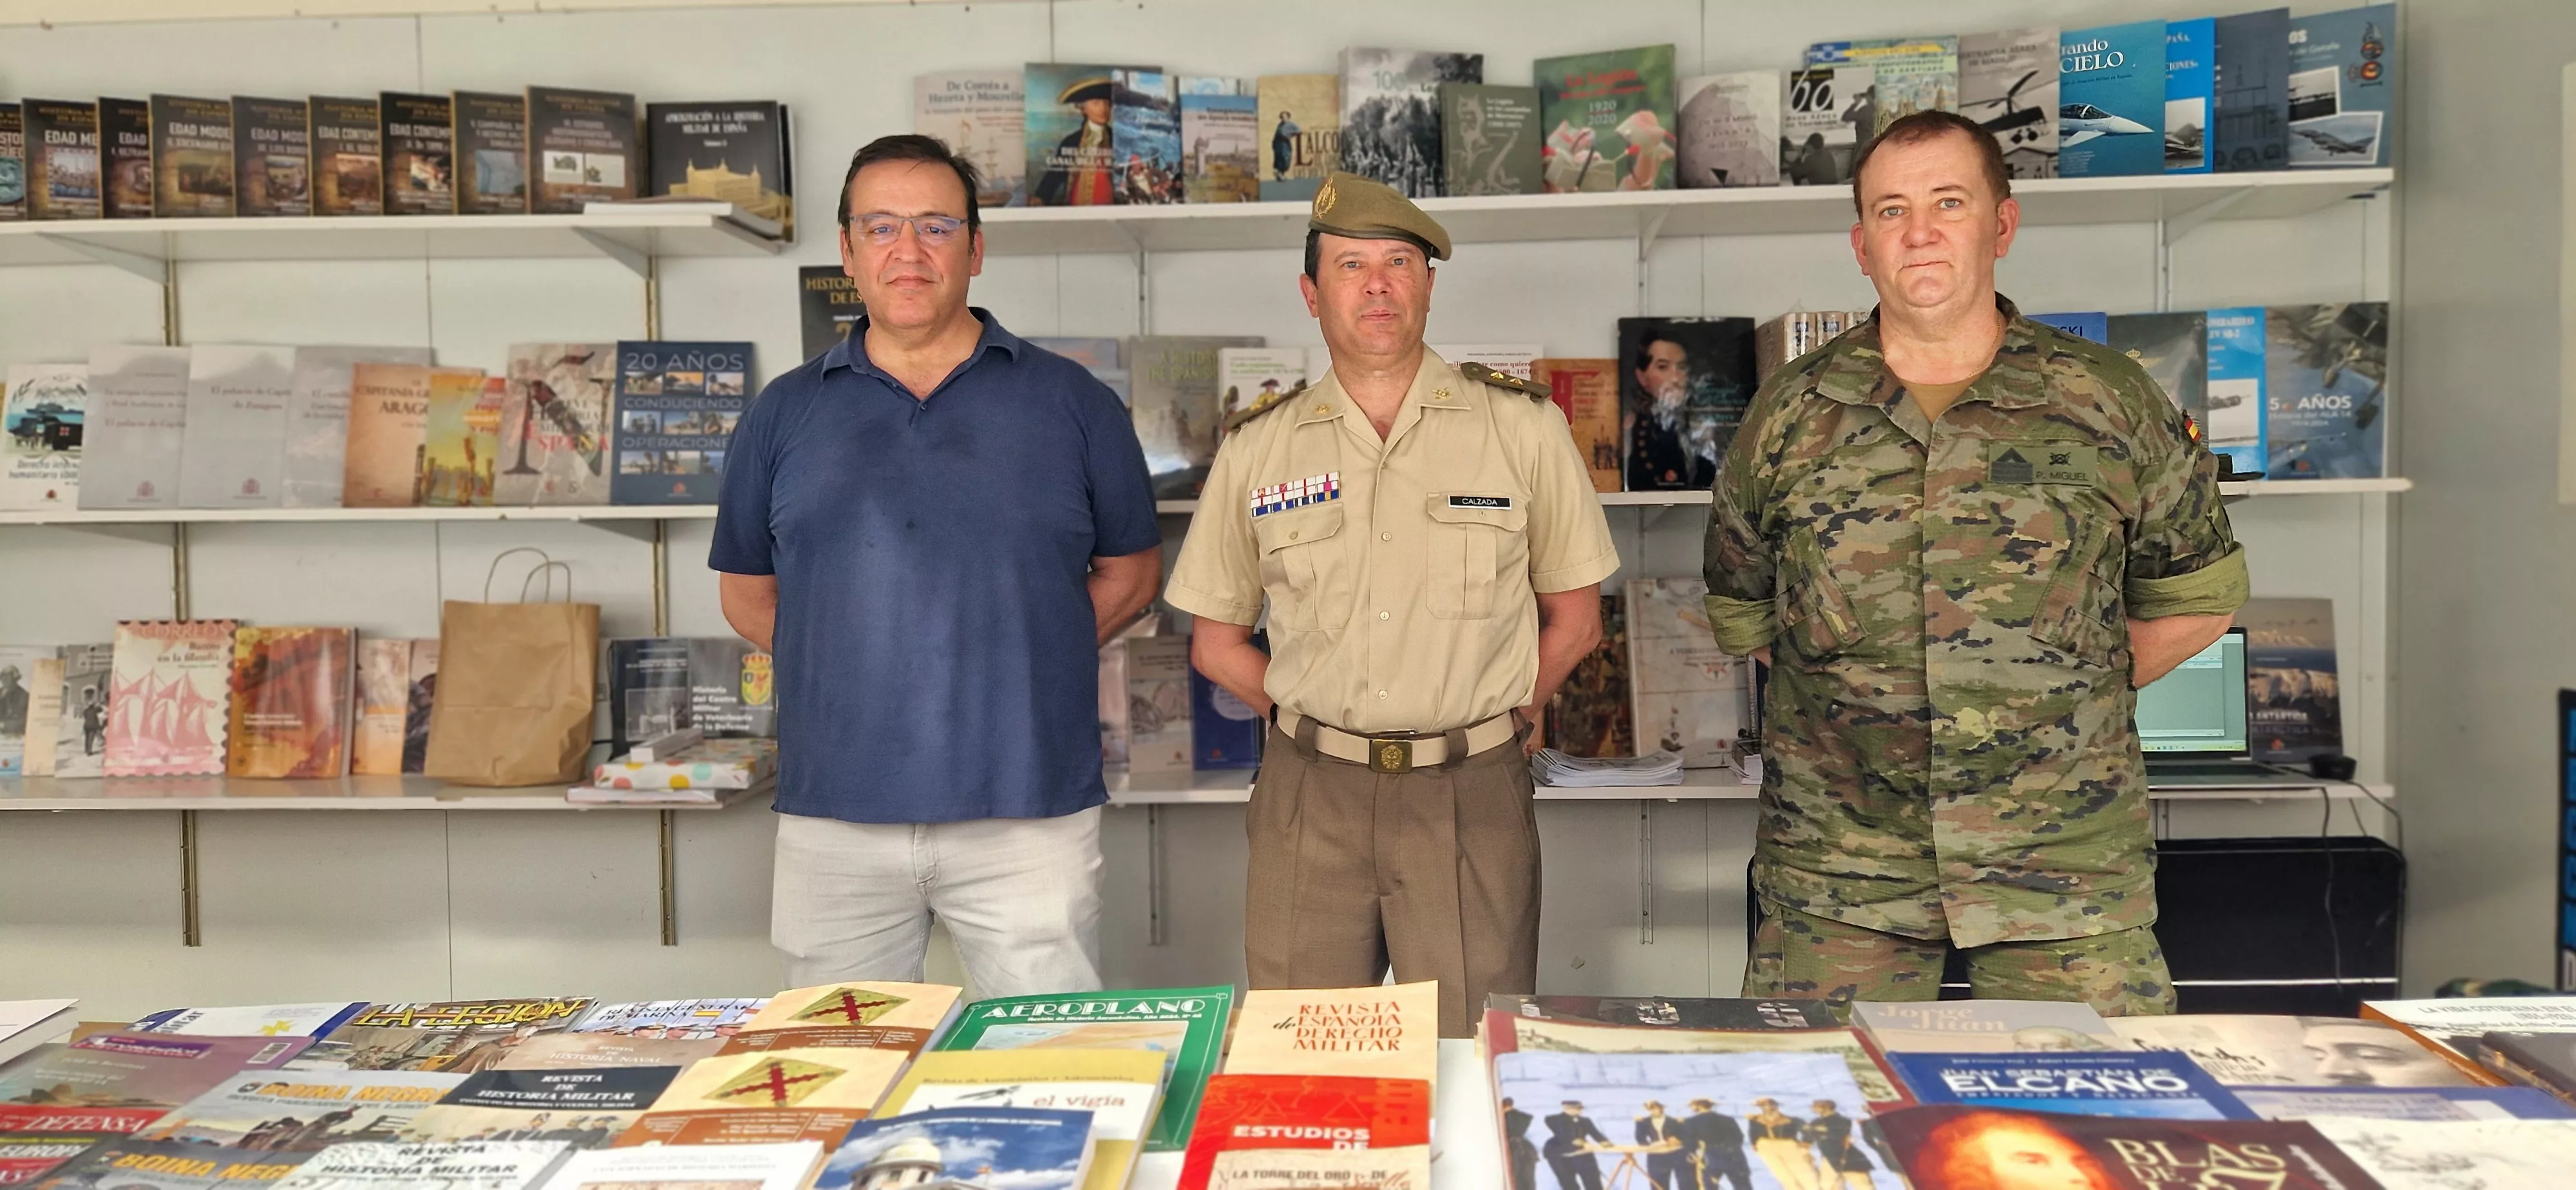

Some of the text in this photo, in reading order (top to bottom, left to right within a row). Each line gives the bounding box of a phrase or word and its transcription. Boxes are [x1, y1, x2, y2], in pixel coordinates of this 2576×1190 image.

[2060, 51, 2124, 74] CIELO
[1588, 99, 1617, 114] 1920
[1587, 113, 1617, 127] 2020
[45, 129, 77, 144] EDAD
[169, 122, 197, 136] EDAD
[118, 132, 147, 145] EDAD
[829, 290, 848, 305] DE
[626, 350, 744, 372] 20 AÑOS
[623, 397, 743, 410] CONDUCIENDO
[2297, 392, 2352, 410] AÑOS
[2036, 471, 2089, 482] P. MIGUEL
[980, 997, 1207, 1020] AEROPLANO
[1299, 1001, 1401, 1016] REVISTA
[1878, 1005, 1973, 1021] Jorge
[354, 1006, 418, 1027] LA
[1273, 1016, 1297, 1031] de
[1297, 1014, 1402, 1028] ESPAÑOLA
[1295, 1026, 1404, 1041] DERECHO
[1293, 1039, 1401, 1053] MILITAR
[550, 1052, 665, 1065] HISTORIA NAVAL
[542, 1074, 603, 1084] REVISTA
[1940, 1075, 2189, 1093] ELCANO
[256, 1083, 352, 1100] BOINA
[477, 1089, 636, 1102] HISTORIA MILITAR
[1032, 1094, 1126, 1109] el vigía
[24, 1115, 149, 1133] DEFENSA
[1233, 1125, 1370, 1142] ESTUDIOS
[1332, 1140, 1371, 1151] DE
[2104, 1138, 2287, 1169] BLAS
[111, 1153, 218, 1177] BOINA
[1232, 1169, 1249, 1180] LA
[1253, 1169, 1293, 1180] TORRE
[1296, 1170, 1320, 1180] DEL
[1324, 1170, 1351, 1180] ORO
[2127, 1164, 2186, 1184] DE
